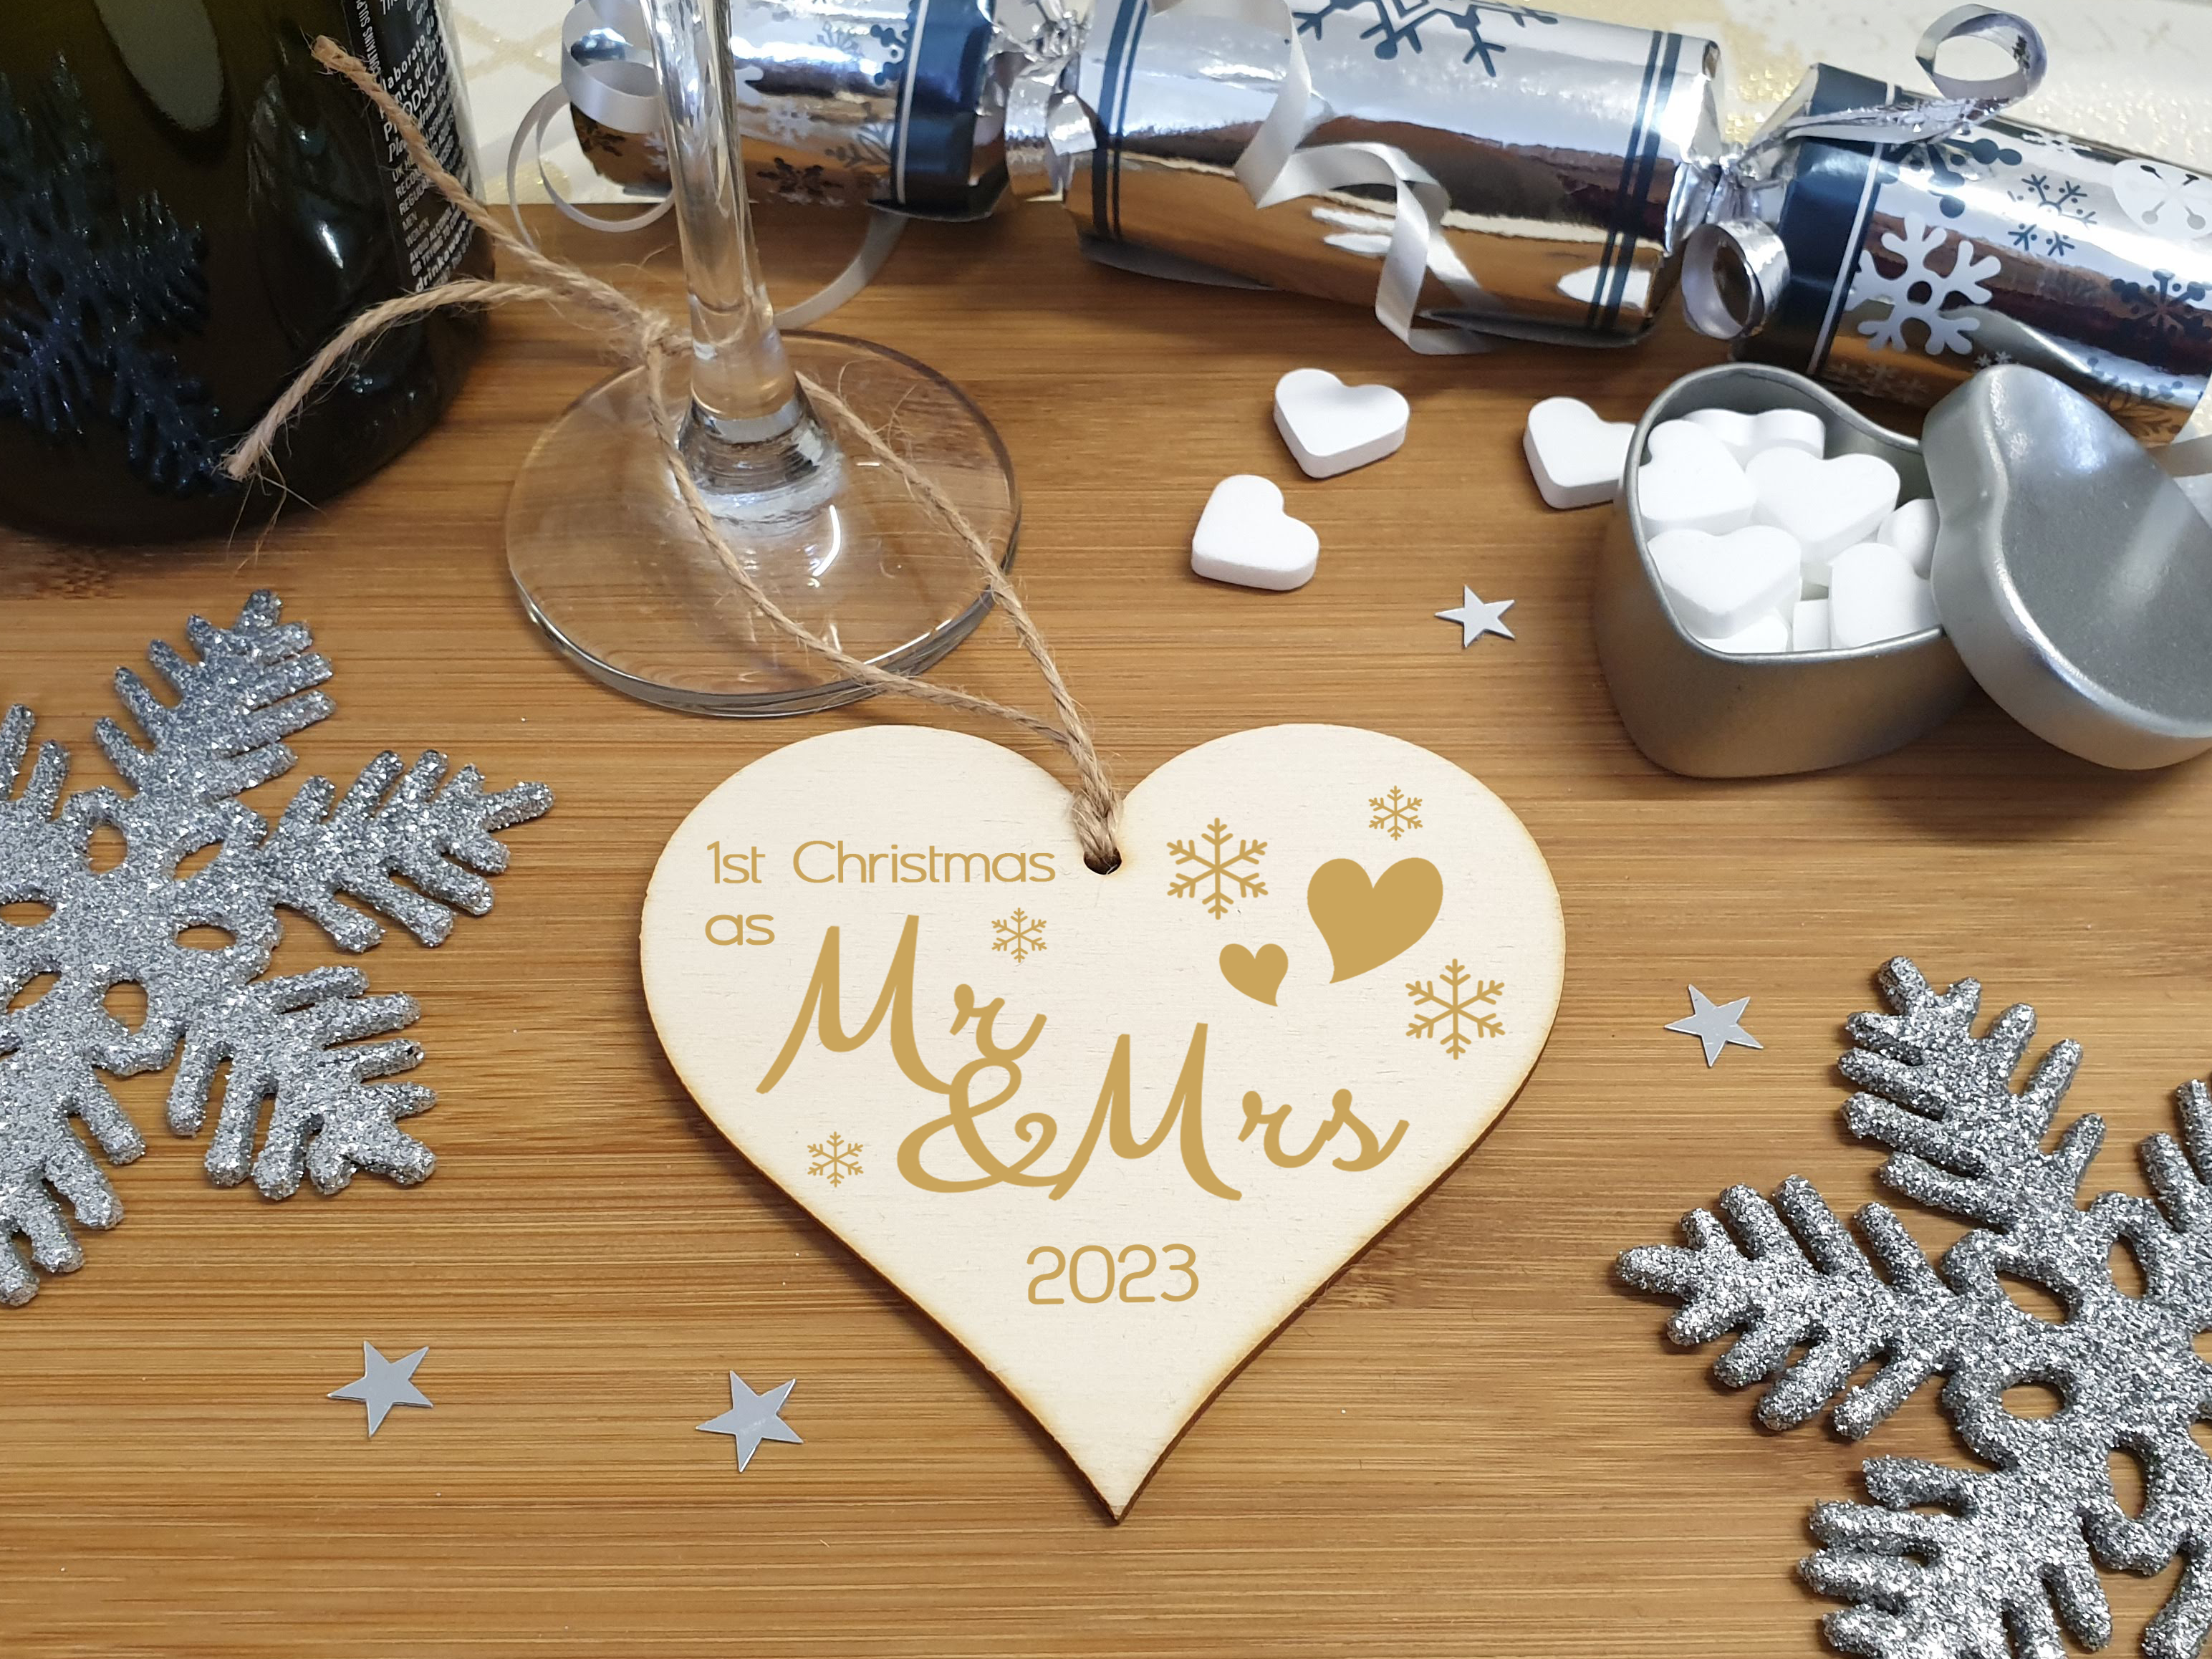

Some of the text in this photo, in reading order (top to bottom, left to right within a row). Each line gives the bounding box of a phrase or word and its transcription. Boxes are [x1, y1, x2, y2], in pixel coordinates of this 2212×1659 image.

[383, 34, 425, 91] laborato
[706, 840, 1056, 884] 1st Christmas
[705, 914, 775, 946] as
[756, 914, 1048, 1095] Mr
[897, 1022, 1410, 1202] & Mrs
[1026, 1243, 1199, 1304] 2023
